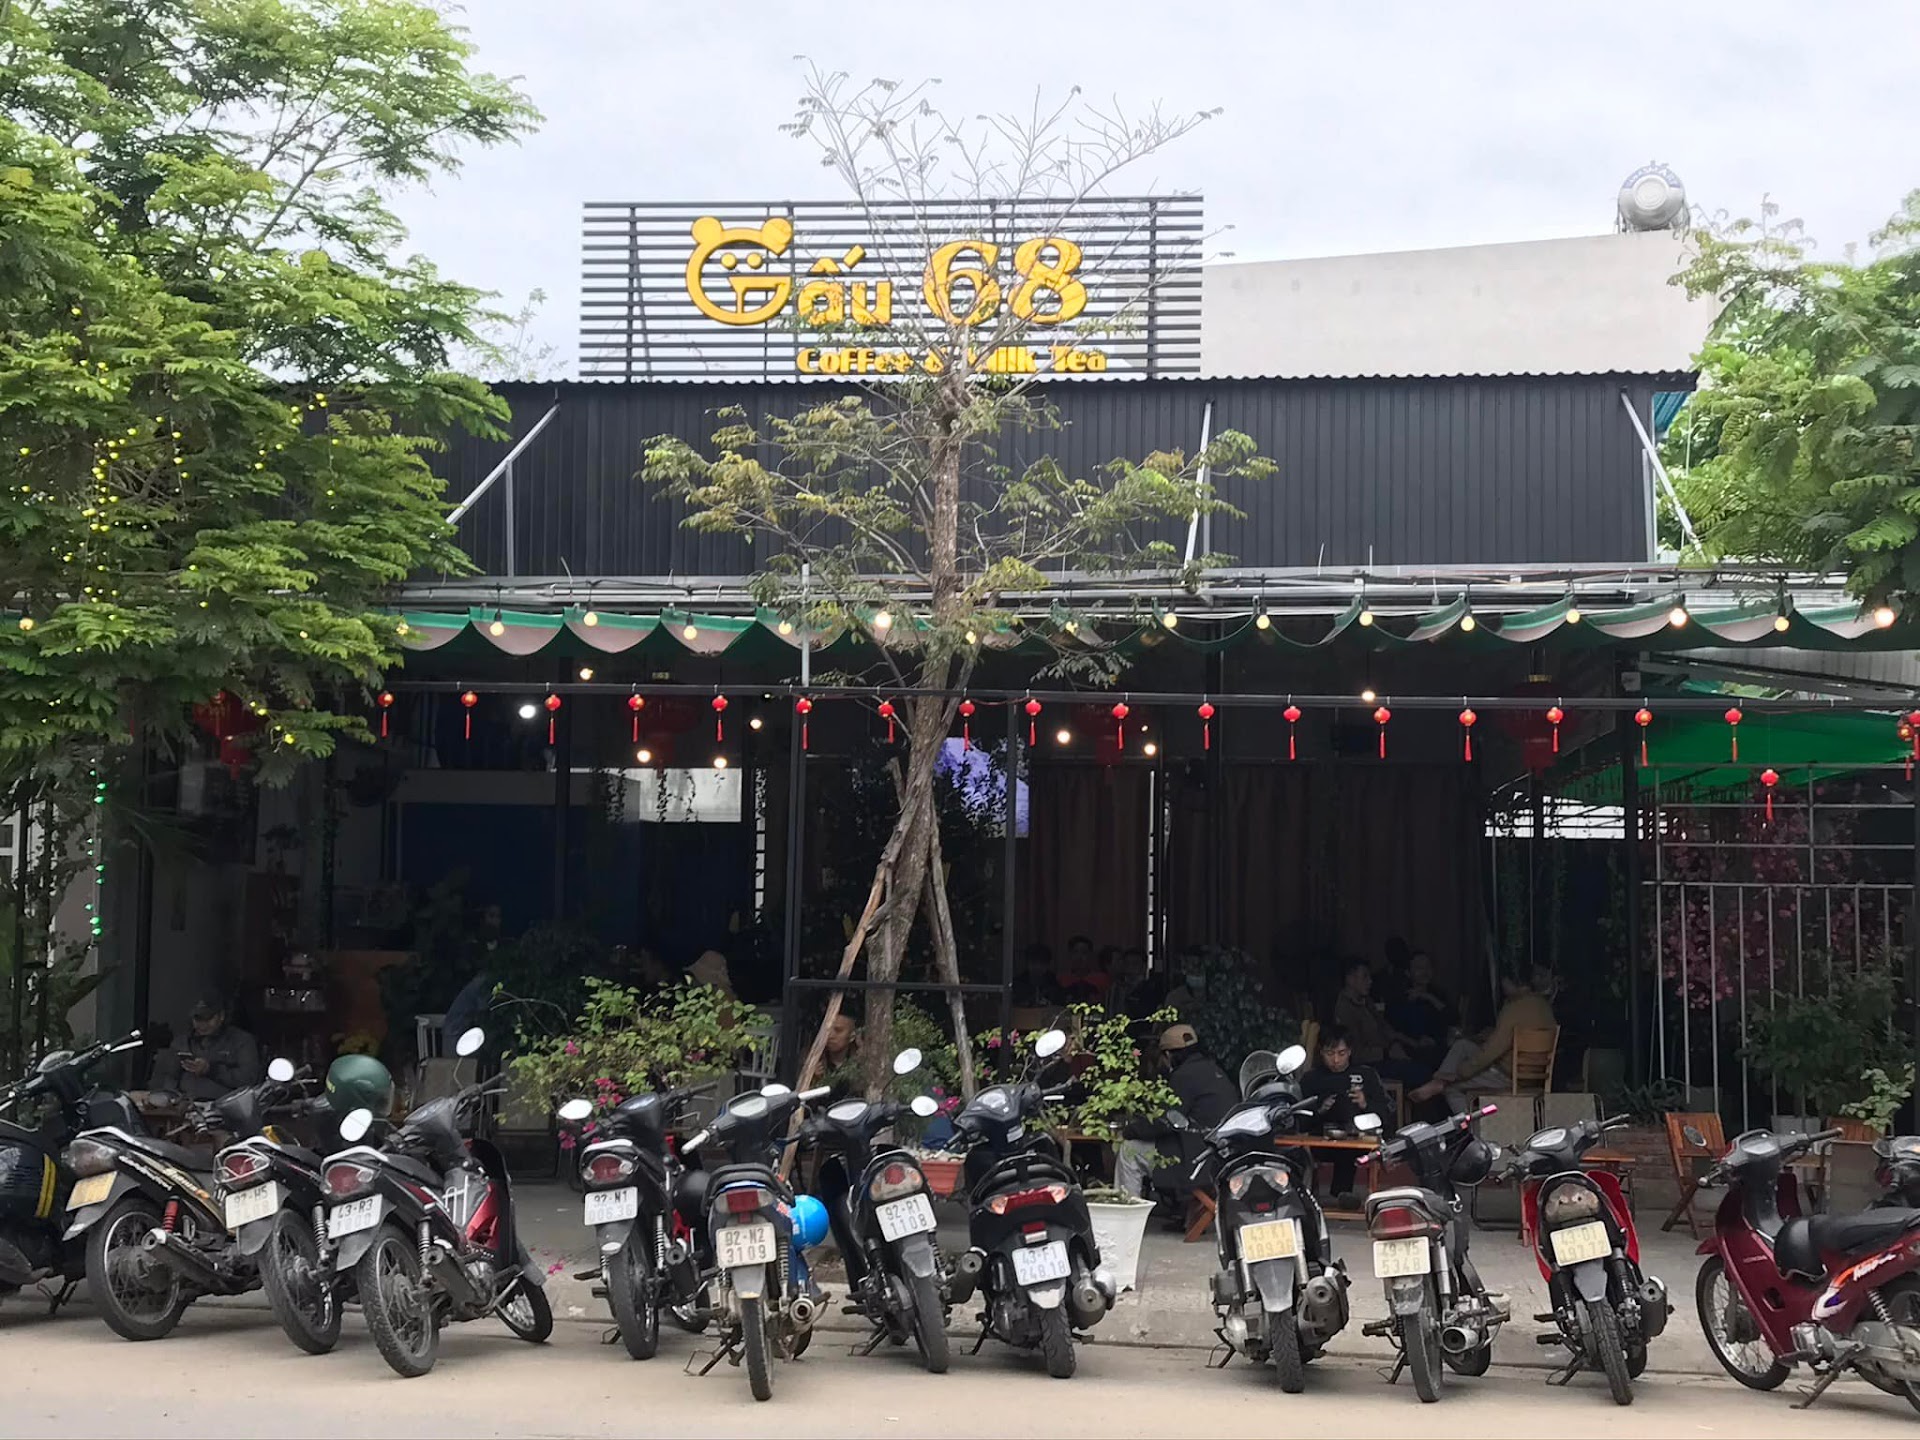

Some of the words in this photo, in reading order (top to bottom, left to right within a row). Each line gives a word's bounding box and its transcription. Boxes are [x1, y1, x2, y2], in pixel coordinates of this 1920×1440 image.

[923, 237, 1087, 326] 68
[796, 347, 914, 375] Coffee
[1048, 345, 1107, 372] Tea
[338, 1198, 373, 1218] 43-R3
[885, 1198, 920, 1220] 92-R1
[890, 1213, 927, 1236] 1108
[725, 1228, 765, 1246] 92-N2
[726, 1245, 766, 1263] 3109
[1022, 1246, 1057, 1264] 43-F1
